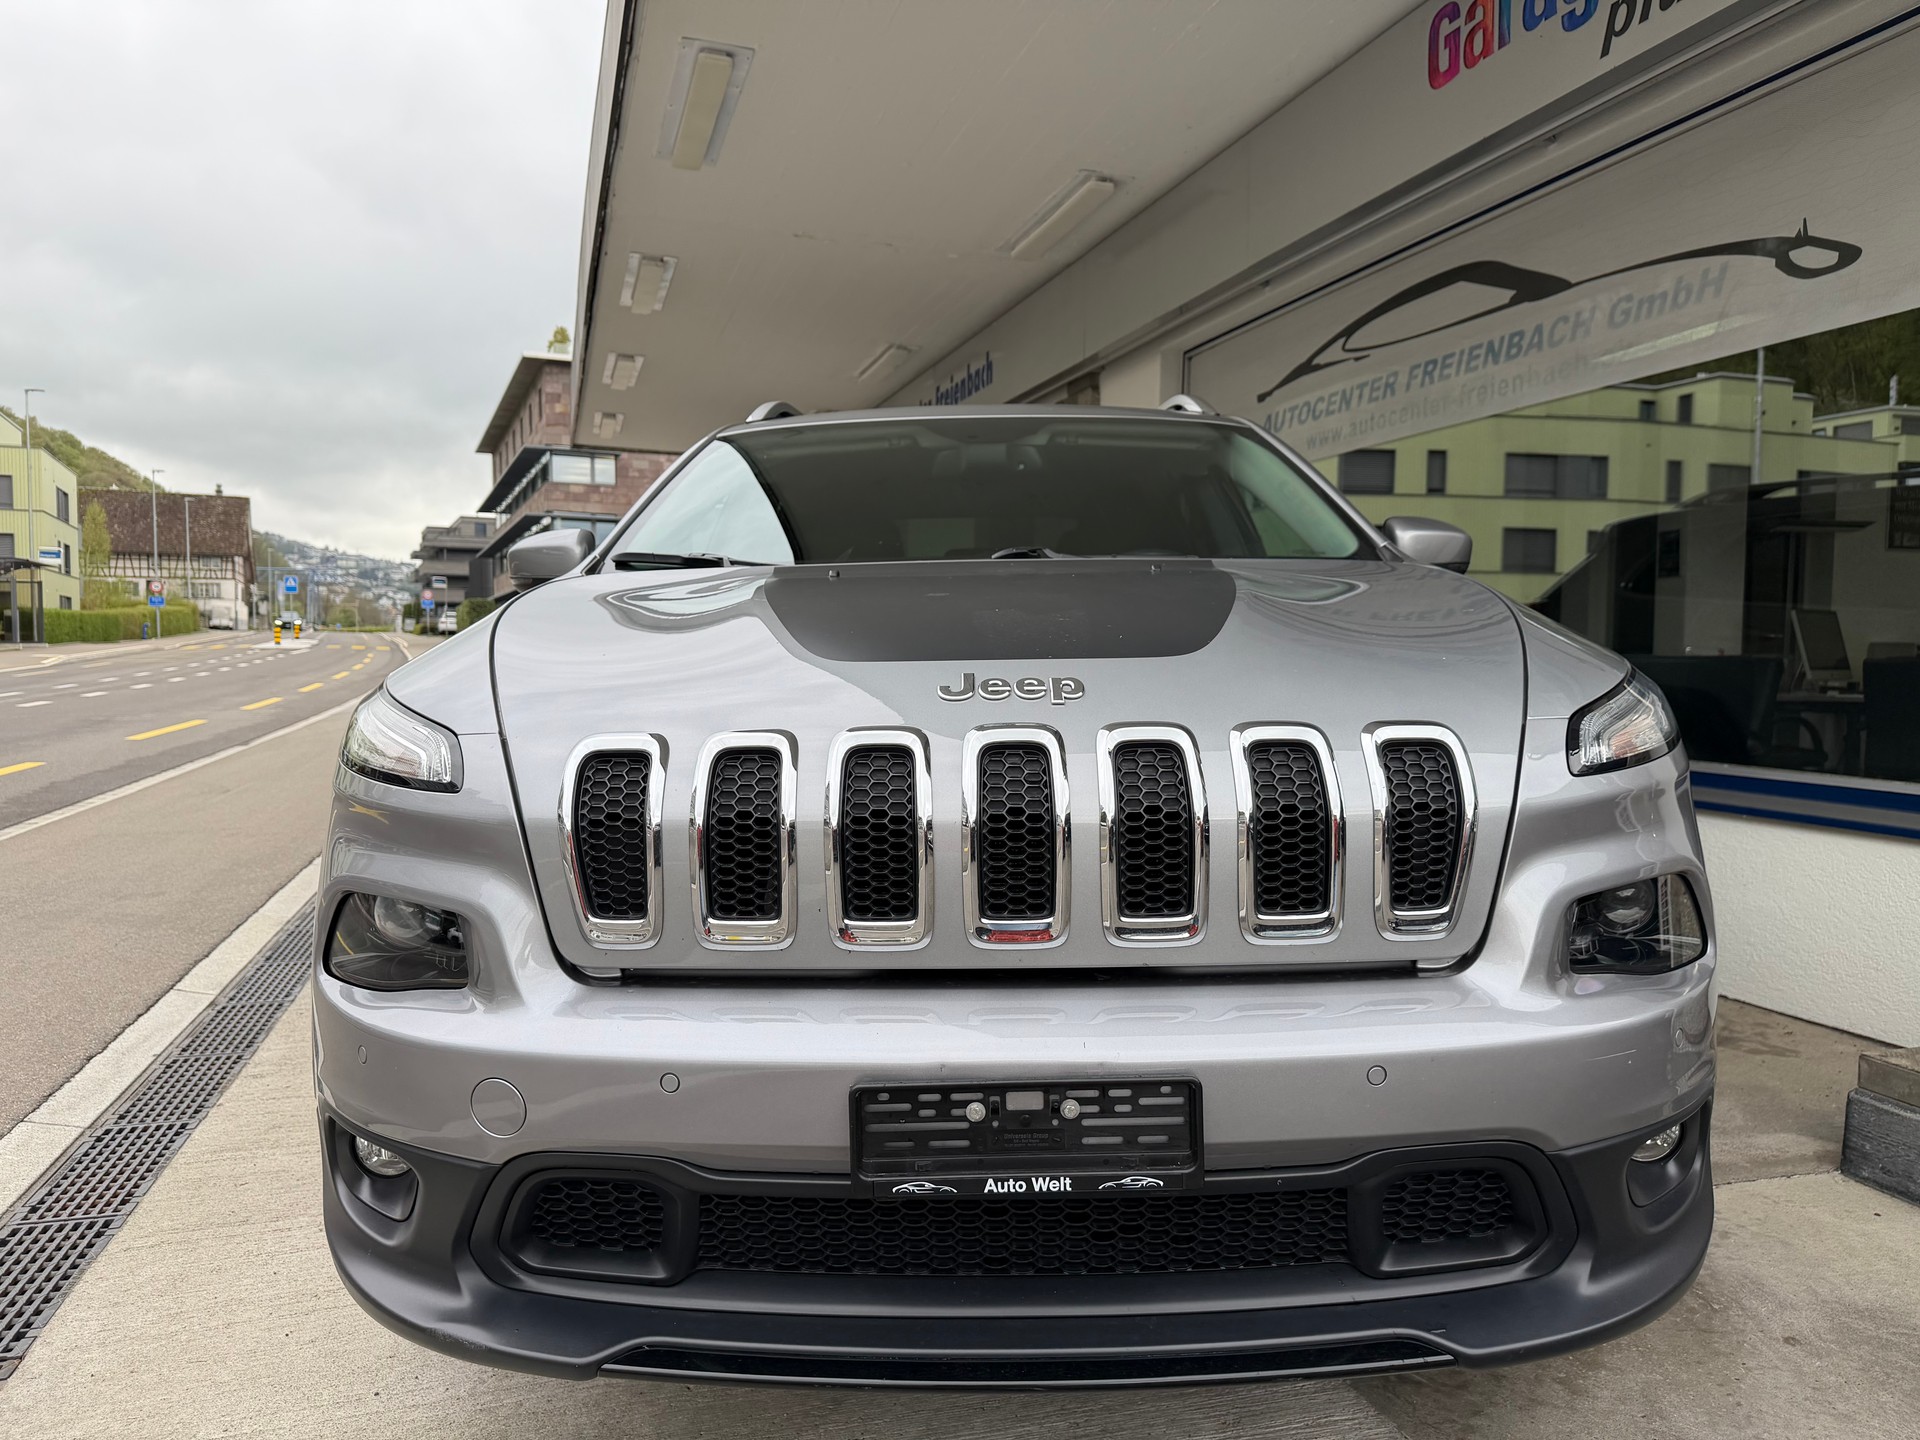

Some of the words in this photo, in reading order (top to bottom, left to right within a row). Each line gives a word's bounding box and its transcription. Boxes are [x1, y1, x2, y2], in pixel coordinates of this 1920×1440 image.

[1263, 371, 1400, 433] AUTOCENTER
[1405, 304, 1597, 392] FREIENBACH
[1607, 261, 1729, 330] GmbH
[937, 672, 1085, 706] Jeep
[984, 1178, 1027, 1194] Auto
[1031, 1176, 1072, 1192] Welt
